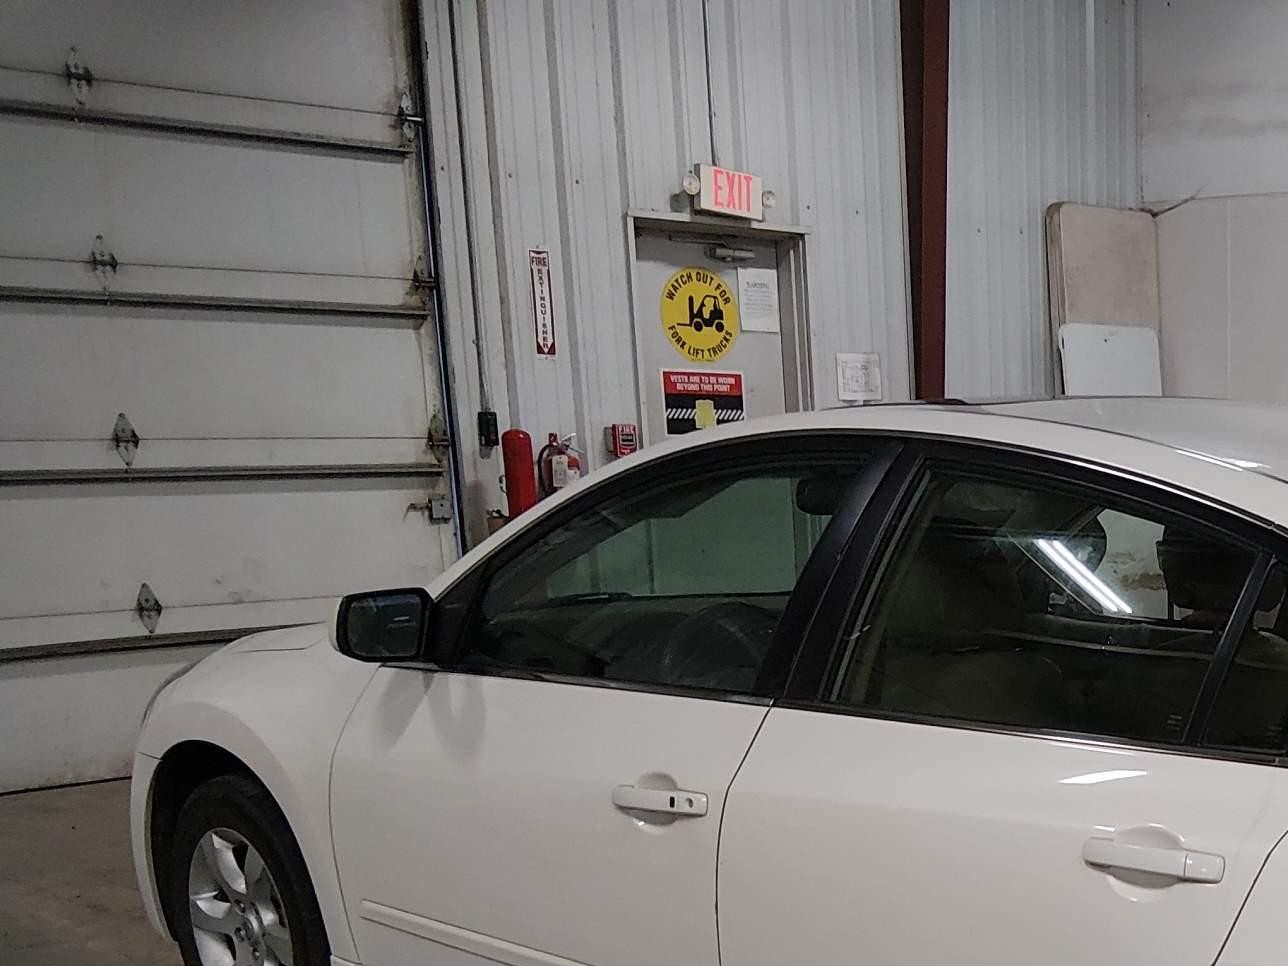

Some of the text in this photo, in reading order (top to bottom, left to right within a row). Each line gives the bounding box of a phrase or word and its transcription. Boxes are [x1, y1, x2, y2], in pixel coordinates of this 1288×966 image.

[713, 168, 753, 212] EXIT
[531, 256, 547, 267] FIRE
[665, 271, 693, 301] WATCH
[695, 271, 714, 287] OUT
[714, 282, 731, 305] FOR
[537, 268, 550, 349] EXTINGUISHER
[667, 324, 733, 359] FORK LIFT TRUCKS
[689, 375, 701, 383] ARE
[701, 376, 709, 384] TO
